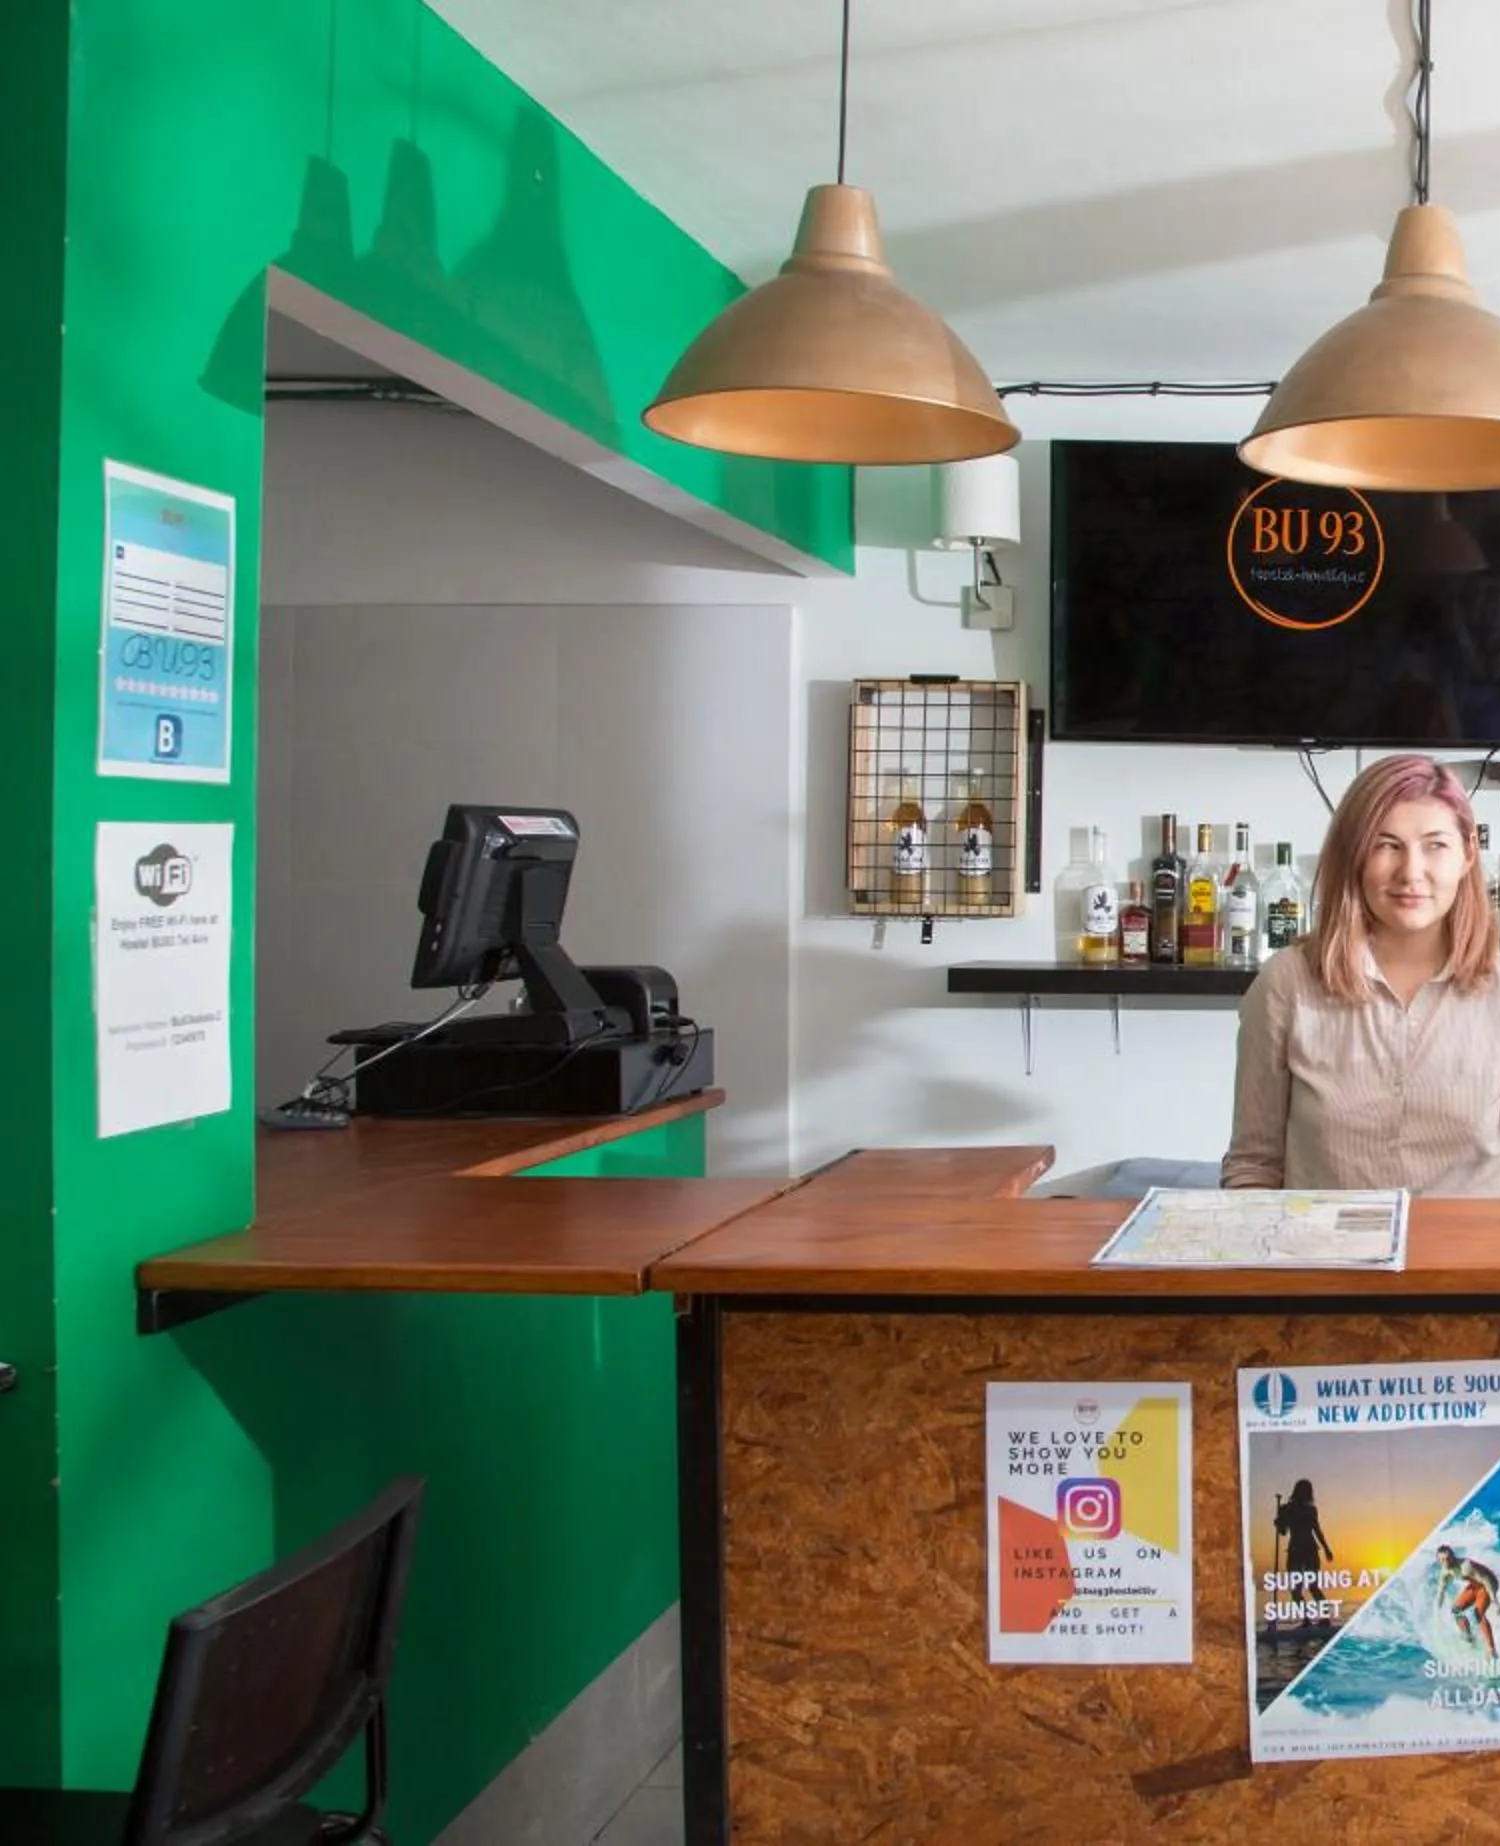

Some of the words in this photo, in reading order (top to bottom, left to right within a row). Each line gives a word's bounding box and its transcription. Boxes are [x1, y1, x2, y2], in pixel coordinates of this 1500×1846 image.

[1252, 507, 1310, 554] BU
[1319, 511, 1365, 556] 93
[138, 915, 165, 929] FREE
[1317, 1379, 1373, 1397] WHAT
[1380, 1376, 1426, 1396] WILL
[1434, 1375, 1456, 1394] BE
[1317, 1405, 1359, 1423] NEW
[1368, 1399, 1486, 1422] ADDICTION?
[1008, 1431, 1040, 1445] WE
[1051, 1431, 1105, 1445] LOVE
[1115, 1431, 1143, 1445] TO
[1008, 1447, 1072, 1460] SHOW
[1083, 1447, 1126, 1460] YOU
[1009, 1462, 1068, 1476] MORE
[1013, 1548, 1054, 1560] LIKE
[1084, 1548, 1107, 1559] US
[1136, 1548, 1161, 1559] ON
[1014, 1567, 1121, 1579] INSTAGRAM
[1263, 1569, 1353, 1592] SUPPING
[1357, 1568, 1383, 1587] AT
[1051, 1606, 1082, 1618] AND
[1110, 1606, 1140, 1618] GET
[1168, 1606, 1177, 1618] A
[1264, 1599, 1343, 1621] SUNSET
[1050, 1624, 1089, 1635] FREE
[1096, 1624, 1143, 1636] SHOT!
[1430, 1687, 1466, 1707] ALL
